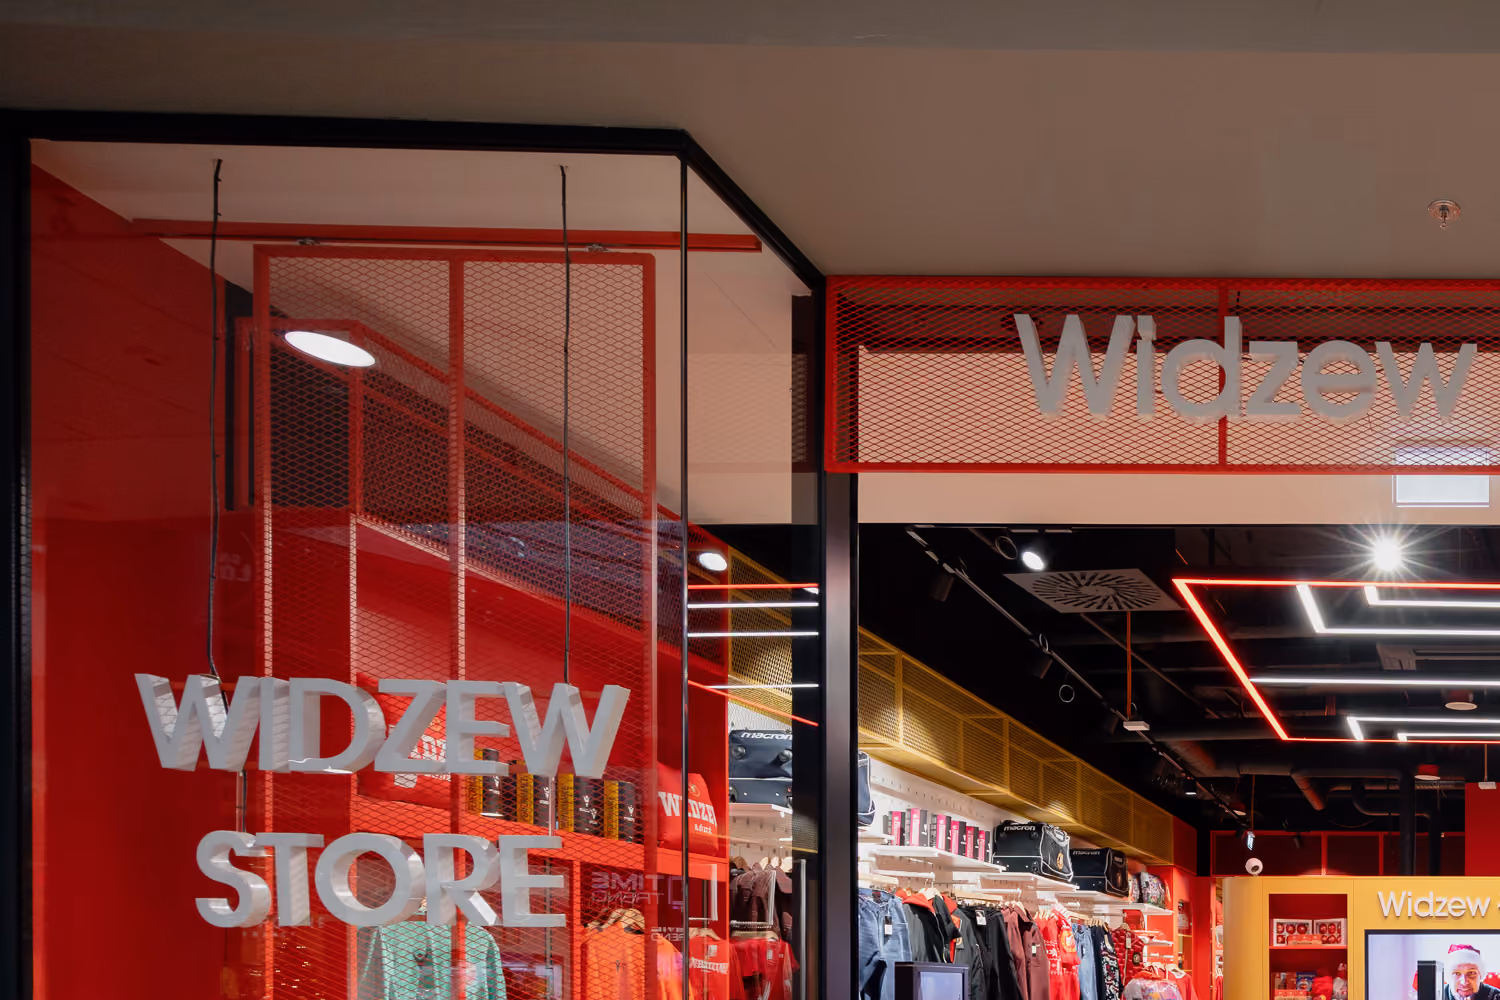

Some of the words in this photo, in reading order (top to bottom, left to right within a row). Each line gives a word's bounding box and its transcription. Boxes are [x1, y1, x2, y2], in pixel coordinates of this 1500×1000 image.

[1013, 313, 1478, 423] Widzew
[135, 673, 631, 779] WIDZEW
[195, 830, 567, 928] STORE
[1378, 890, 1491, 918] Widzew
